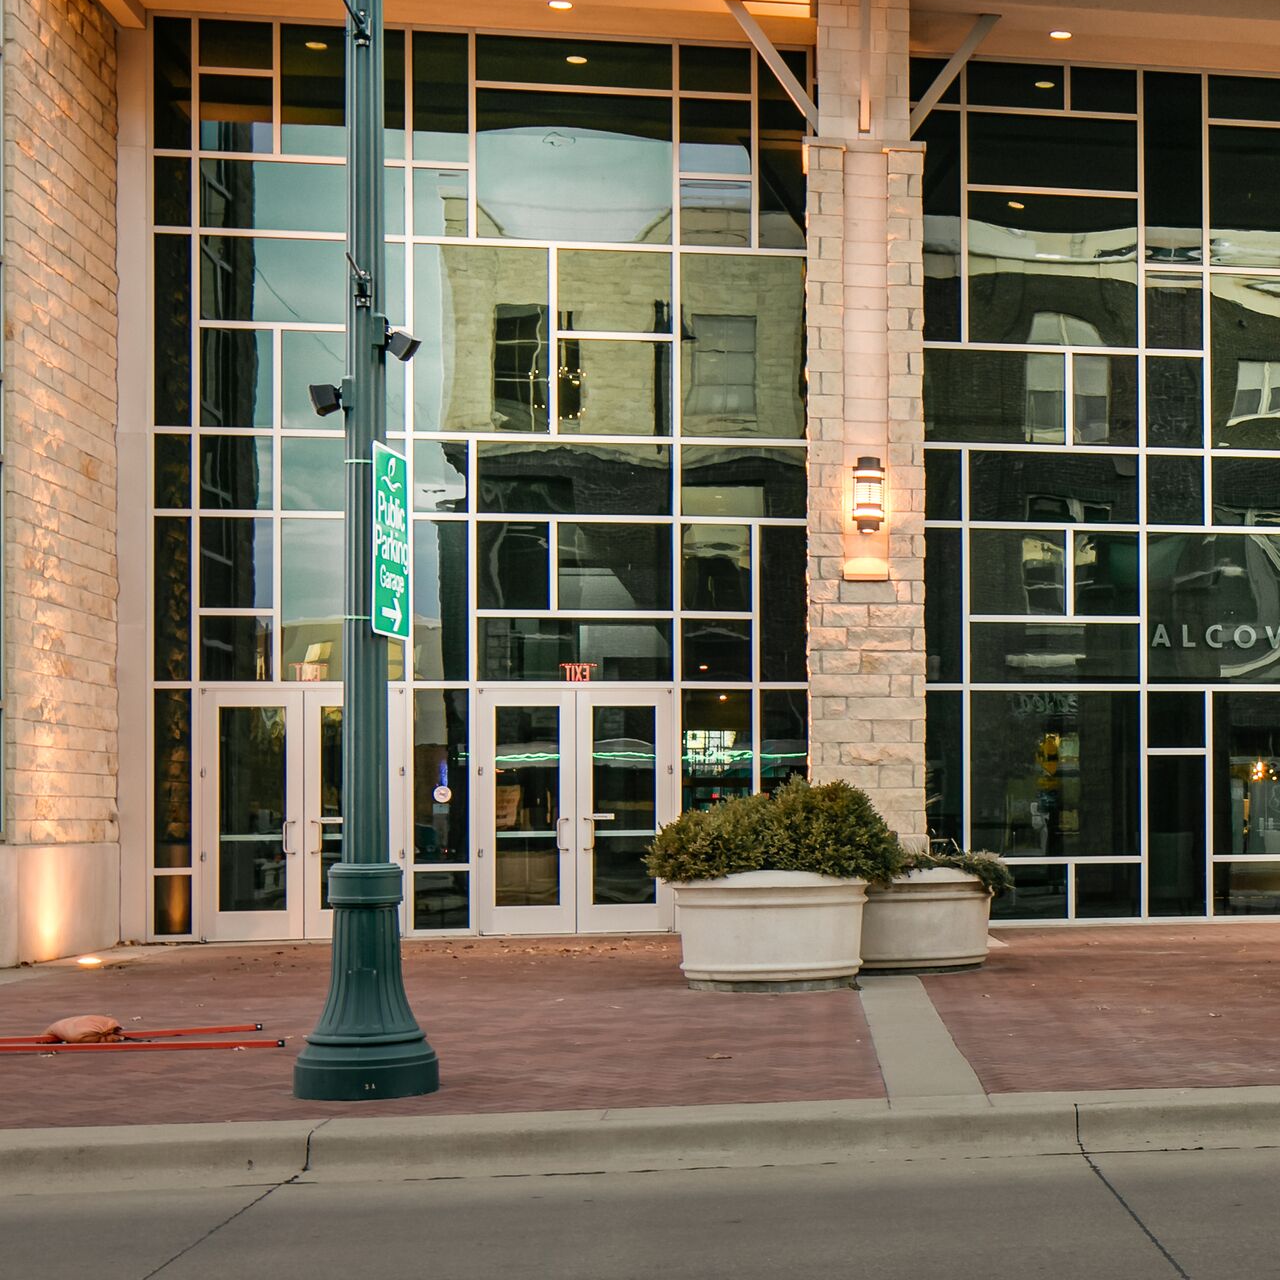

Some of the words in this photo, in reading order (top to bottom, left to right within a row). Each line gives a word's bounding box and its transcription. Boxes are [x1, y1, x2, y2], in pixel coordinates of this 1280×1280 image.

[377, 490, 405, 532] Public
[375, 524, 409, 575] Parking
[380, 564, 404, 598] Garage
